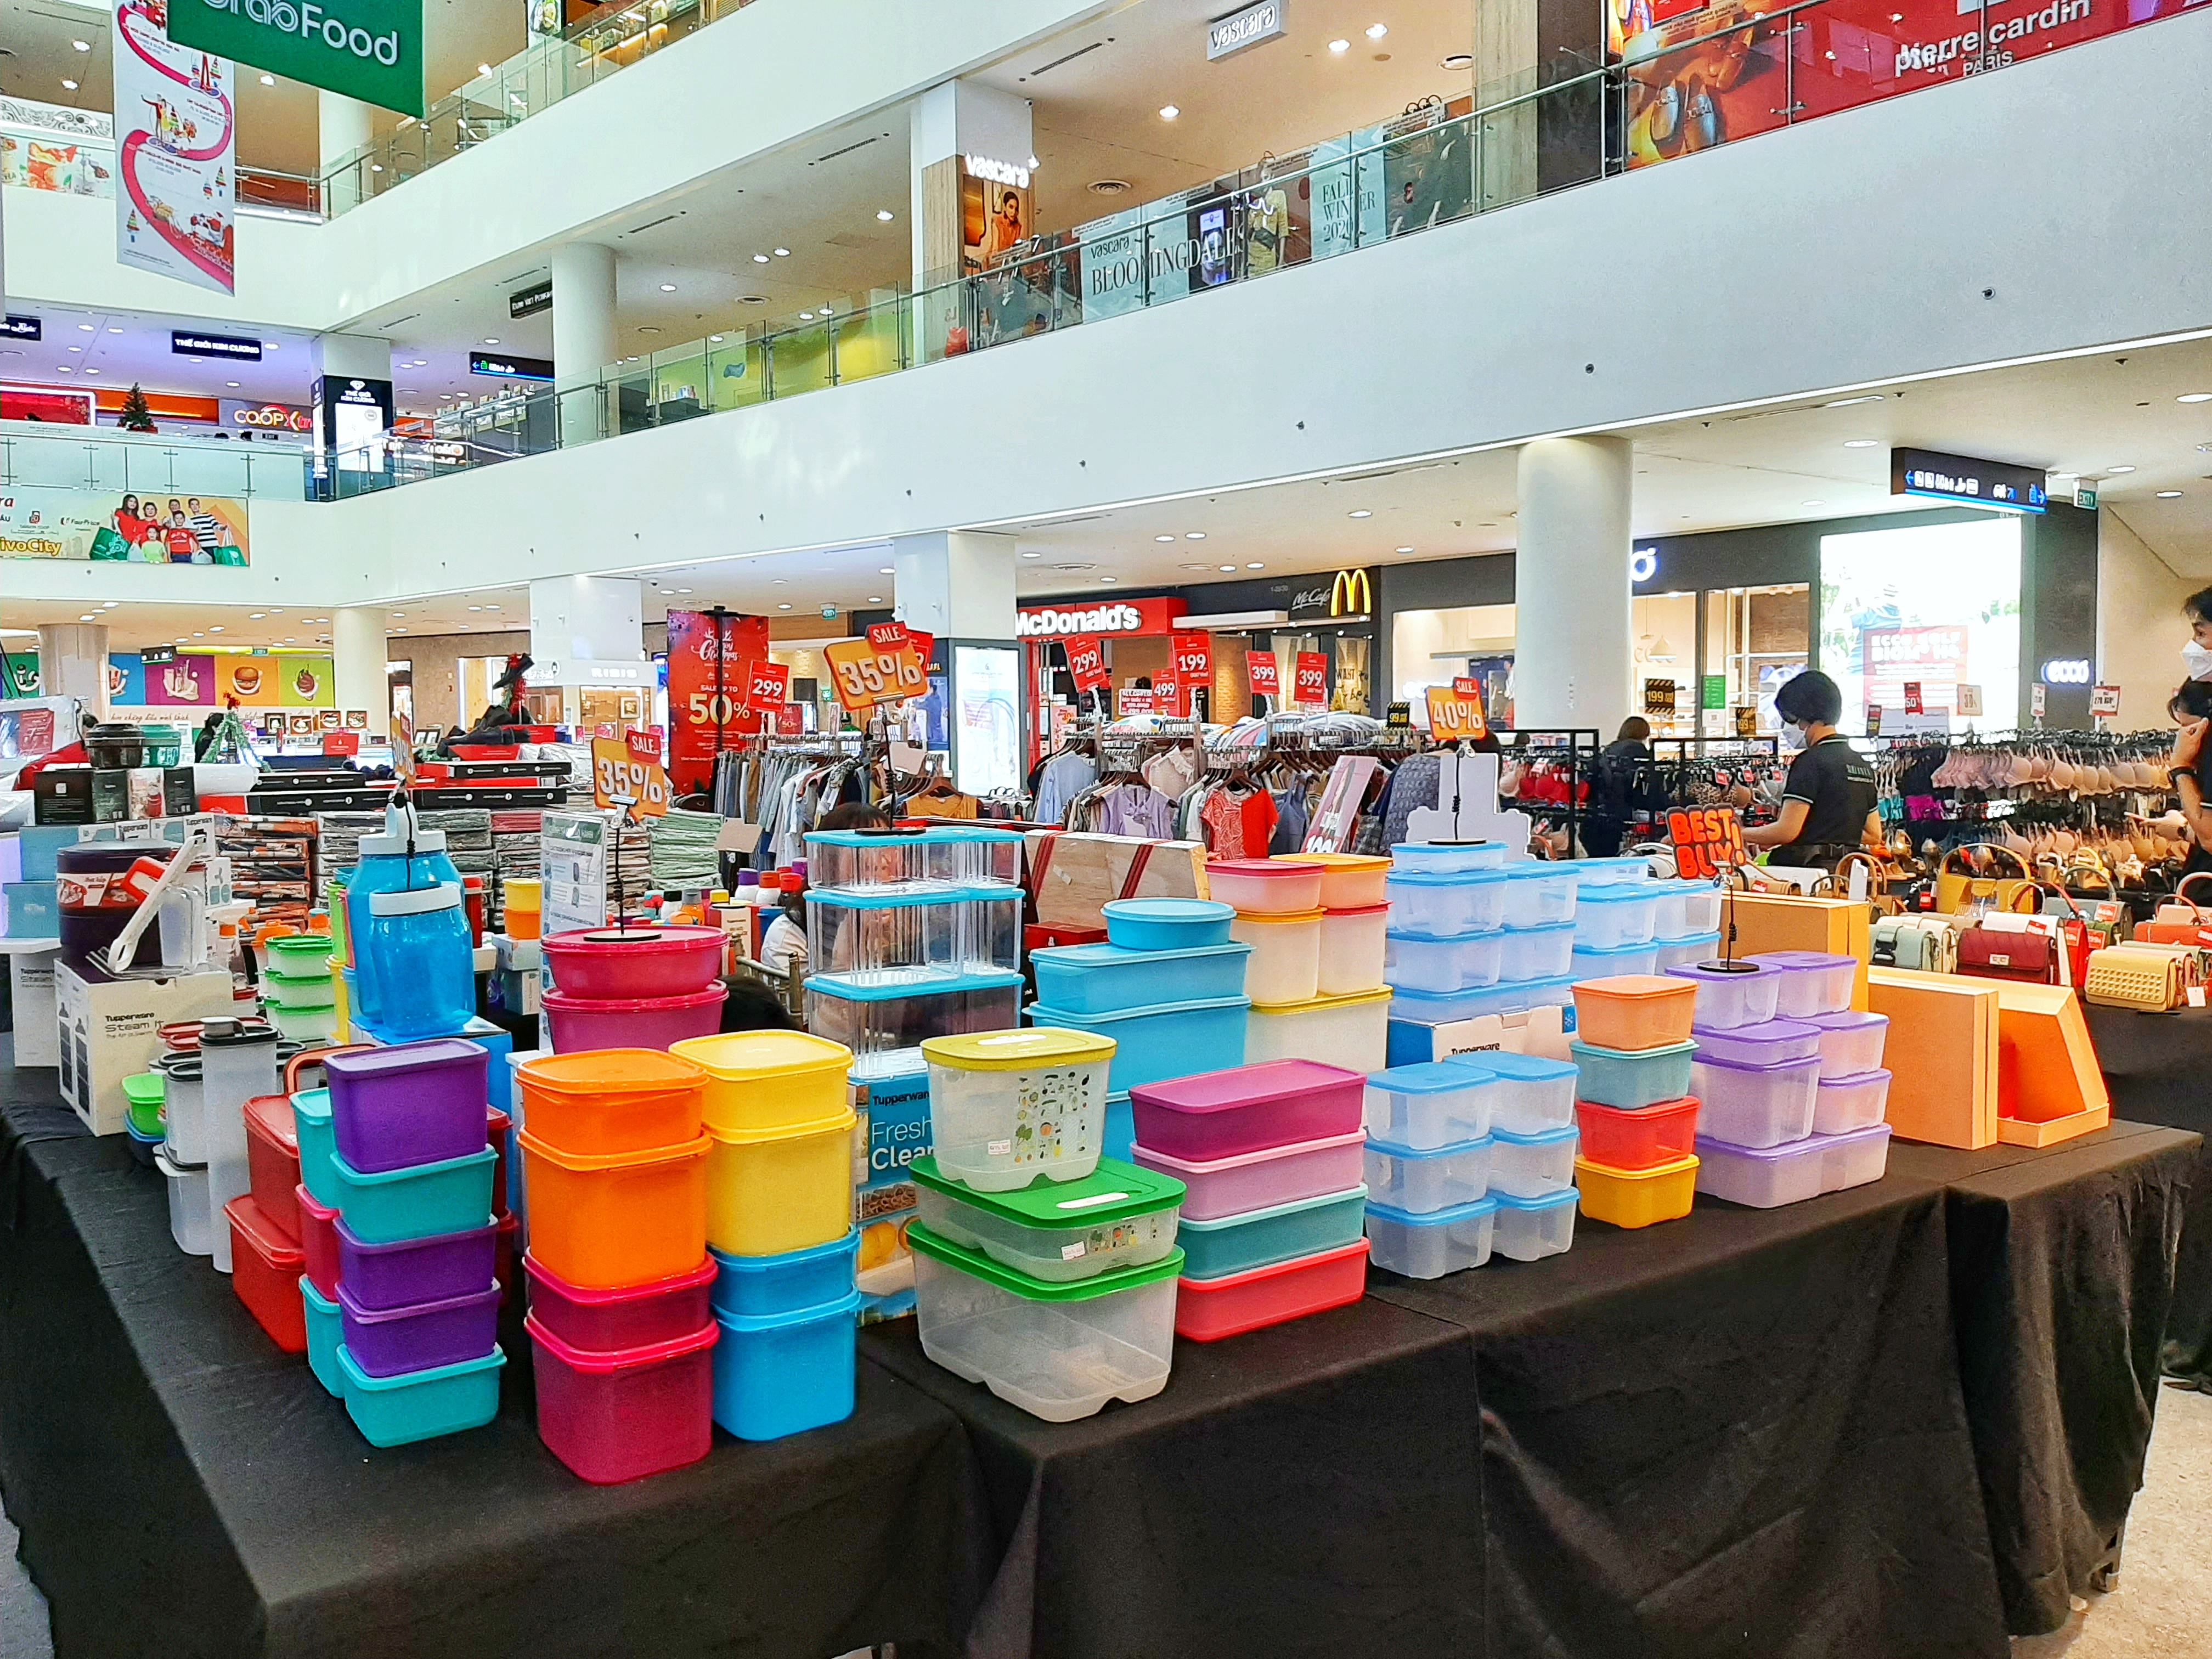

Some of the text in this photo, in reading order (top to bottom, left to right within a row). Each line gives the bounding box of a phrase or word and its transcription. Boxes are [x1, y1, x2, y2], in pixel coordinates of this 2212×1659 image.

[1211, 5, 1276, 50] vascara
[1989, 0, 2091, 44] cardin
[965, 151, 1030, 189] vascara
[1091, 235, 1130, 259] vascara
[873, 626, 901, 644] SALE
[1015, 605, 1140, 636] McDonald's
[838, 652, 921, 695] 35%
[1455, 681, 1474, 692] SALE
[1646, 691, 1664, 703] 199
[1433, 701, 1482, 730] 40%
[632, 736, 654, 754] SALE
[598, 757, 663, 803] 35%
[1669, 808, 1733, 845] BEST
